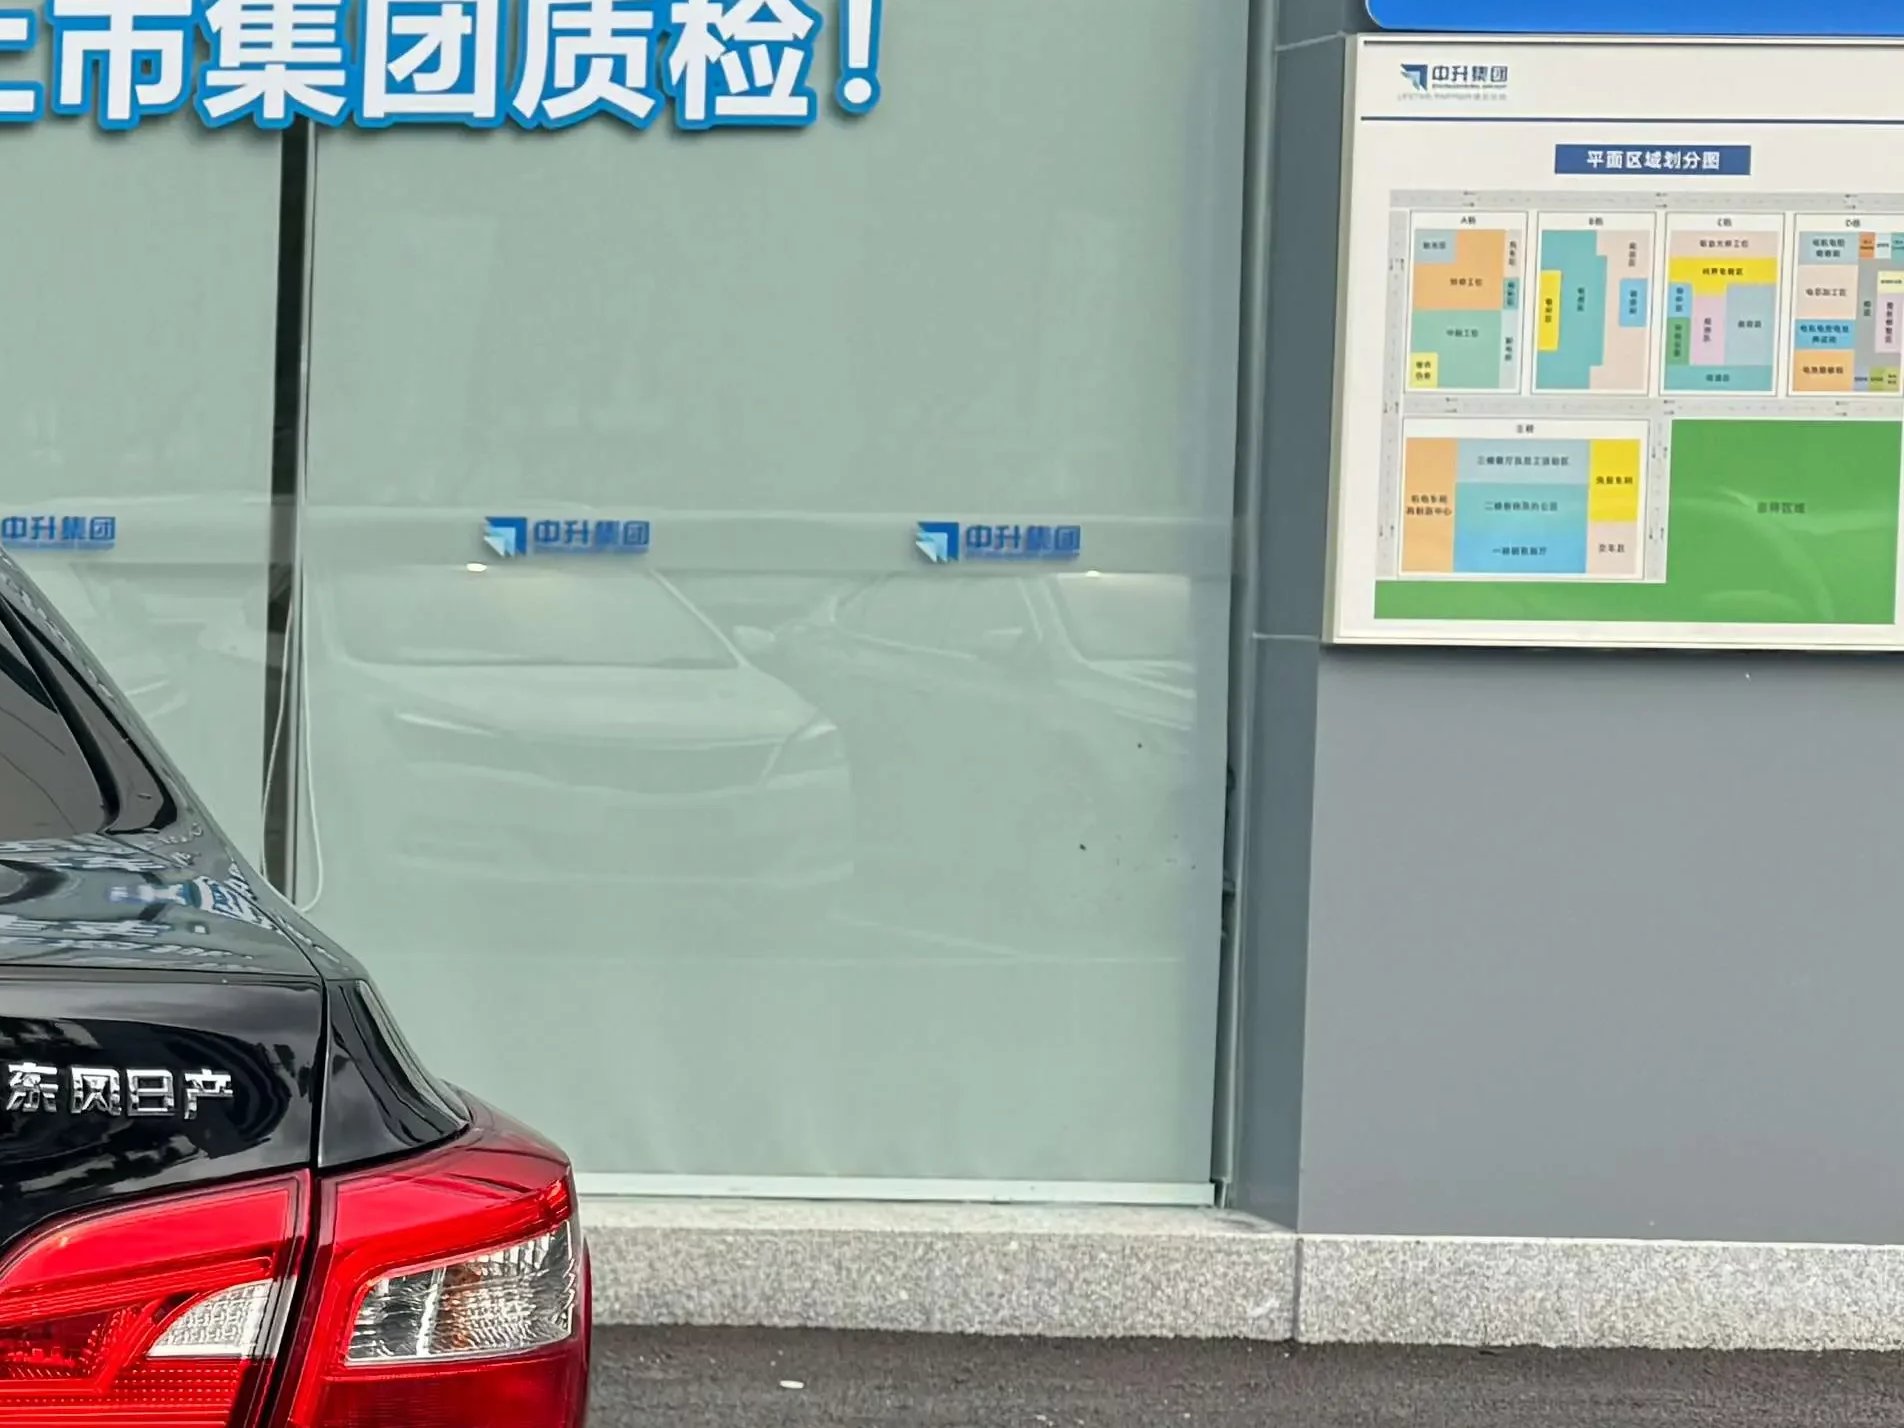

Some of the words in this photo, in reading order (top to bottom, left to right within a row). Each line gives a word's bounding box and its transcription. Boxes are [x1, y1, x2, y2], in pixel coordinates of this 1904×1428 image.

[1431, 65, 1509, 83] 中升集团
[1586, 150, 1721, 170] 平面区域划分图
[0, 515, 117, 542] 中升集团
[534, 519, 651, 545] 中升集团
[5, 1061, 234, 1119] 东风日产
